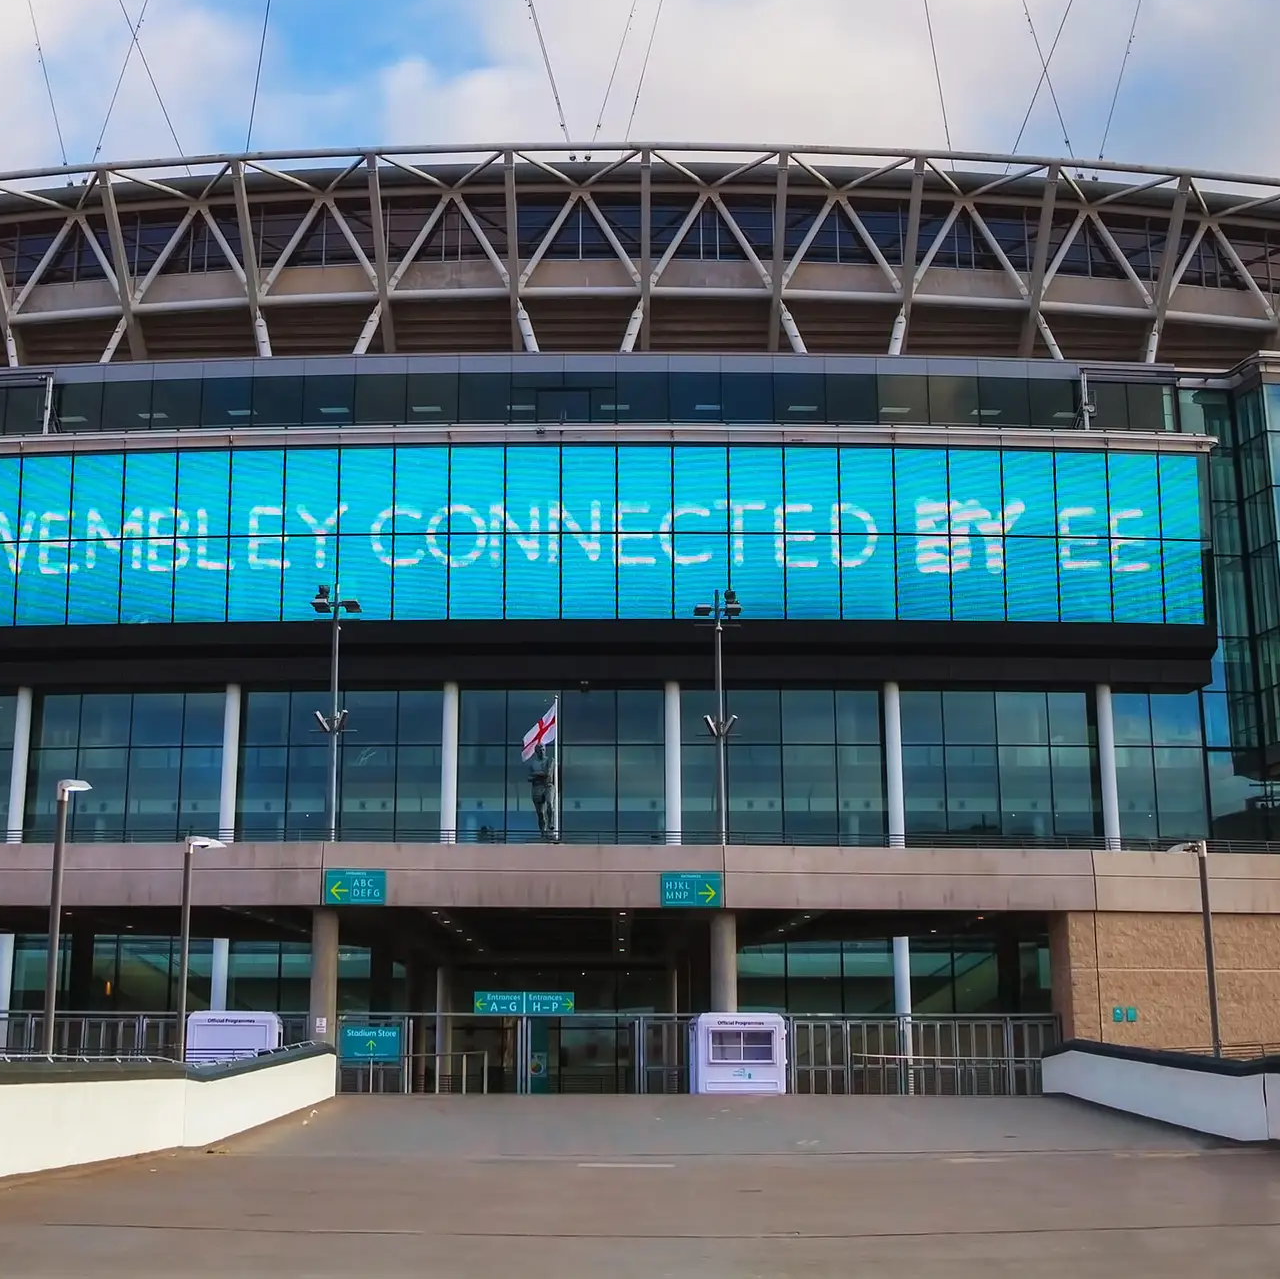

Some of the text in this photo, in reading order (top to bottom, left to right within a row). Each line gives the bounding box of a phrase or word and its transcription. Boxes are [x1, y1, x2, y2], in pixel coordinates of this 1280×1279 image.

[370, 500, 878, 568] CONNECTED
[915, 497, 1025, 574] BY
[1058, 507, 1150, 572] EE
[346, 1028, 397, 1037] Stadium Store
